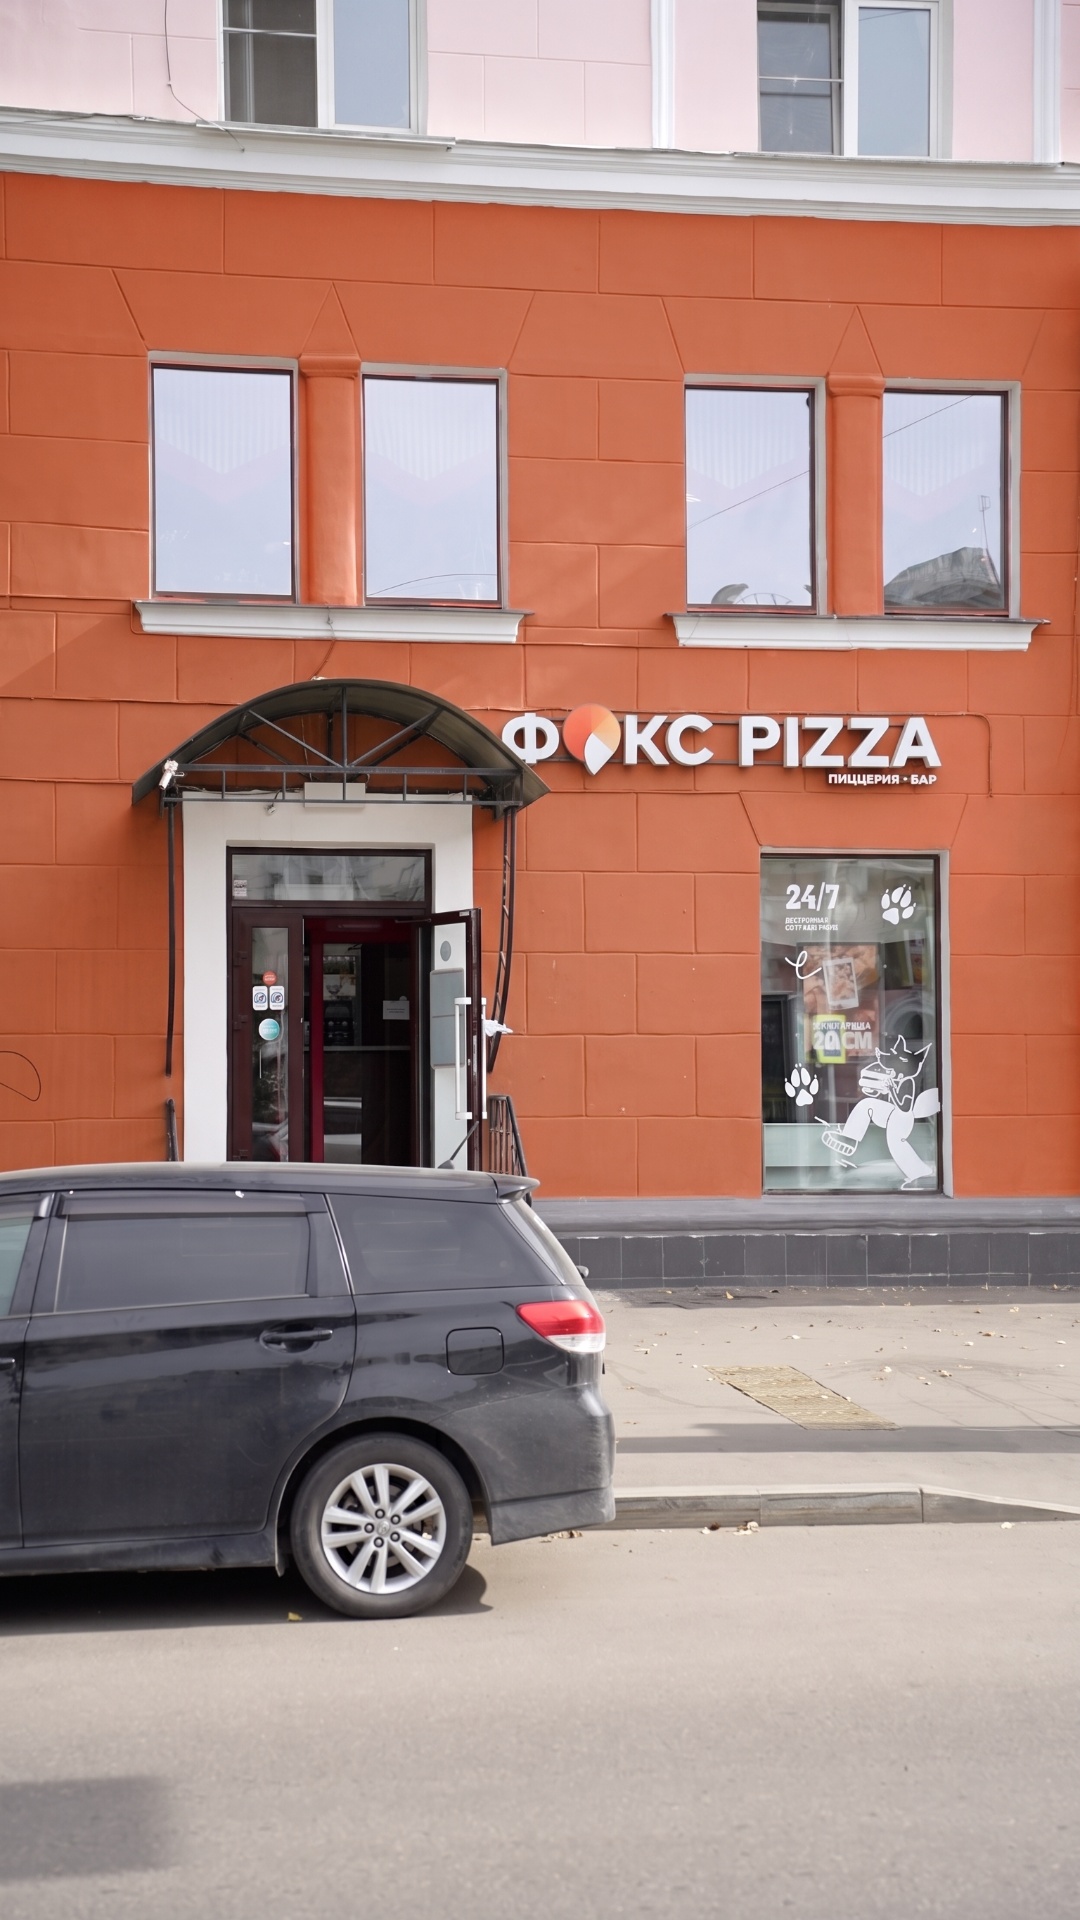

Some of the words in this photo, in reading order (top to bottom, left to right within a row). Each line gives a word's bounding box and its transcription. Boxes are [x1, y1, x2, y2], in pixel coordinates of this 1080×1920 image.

[739, 716, 942, 769] PIZZA
[828, 773, 900, 786] ПИЦЦЕРИЯ
[910, 774, 937, 785] БАР
[786, 882, 840, 911] 24/7
